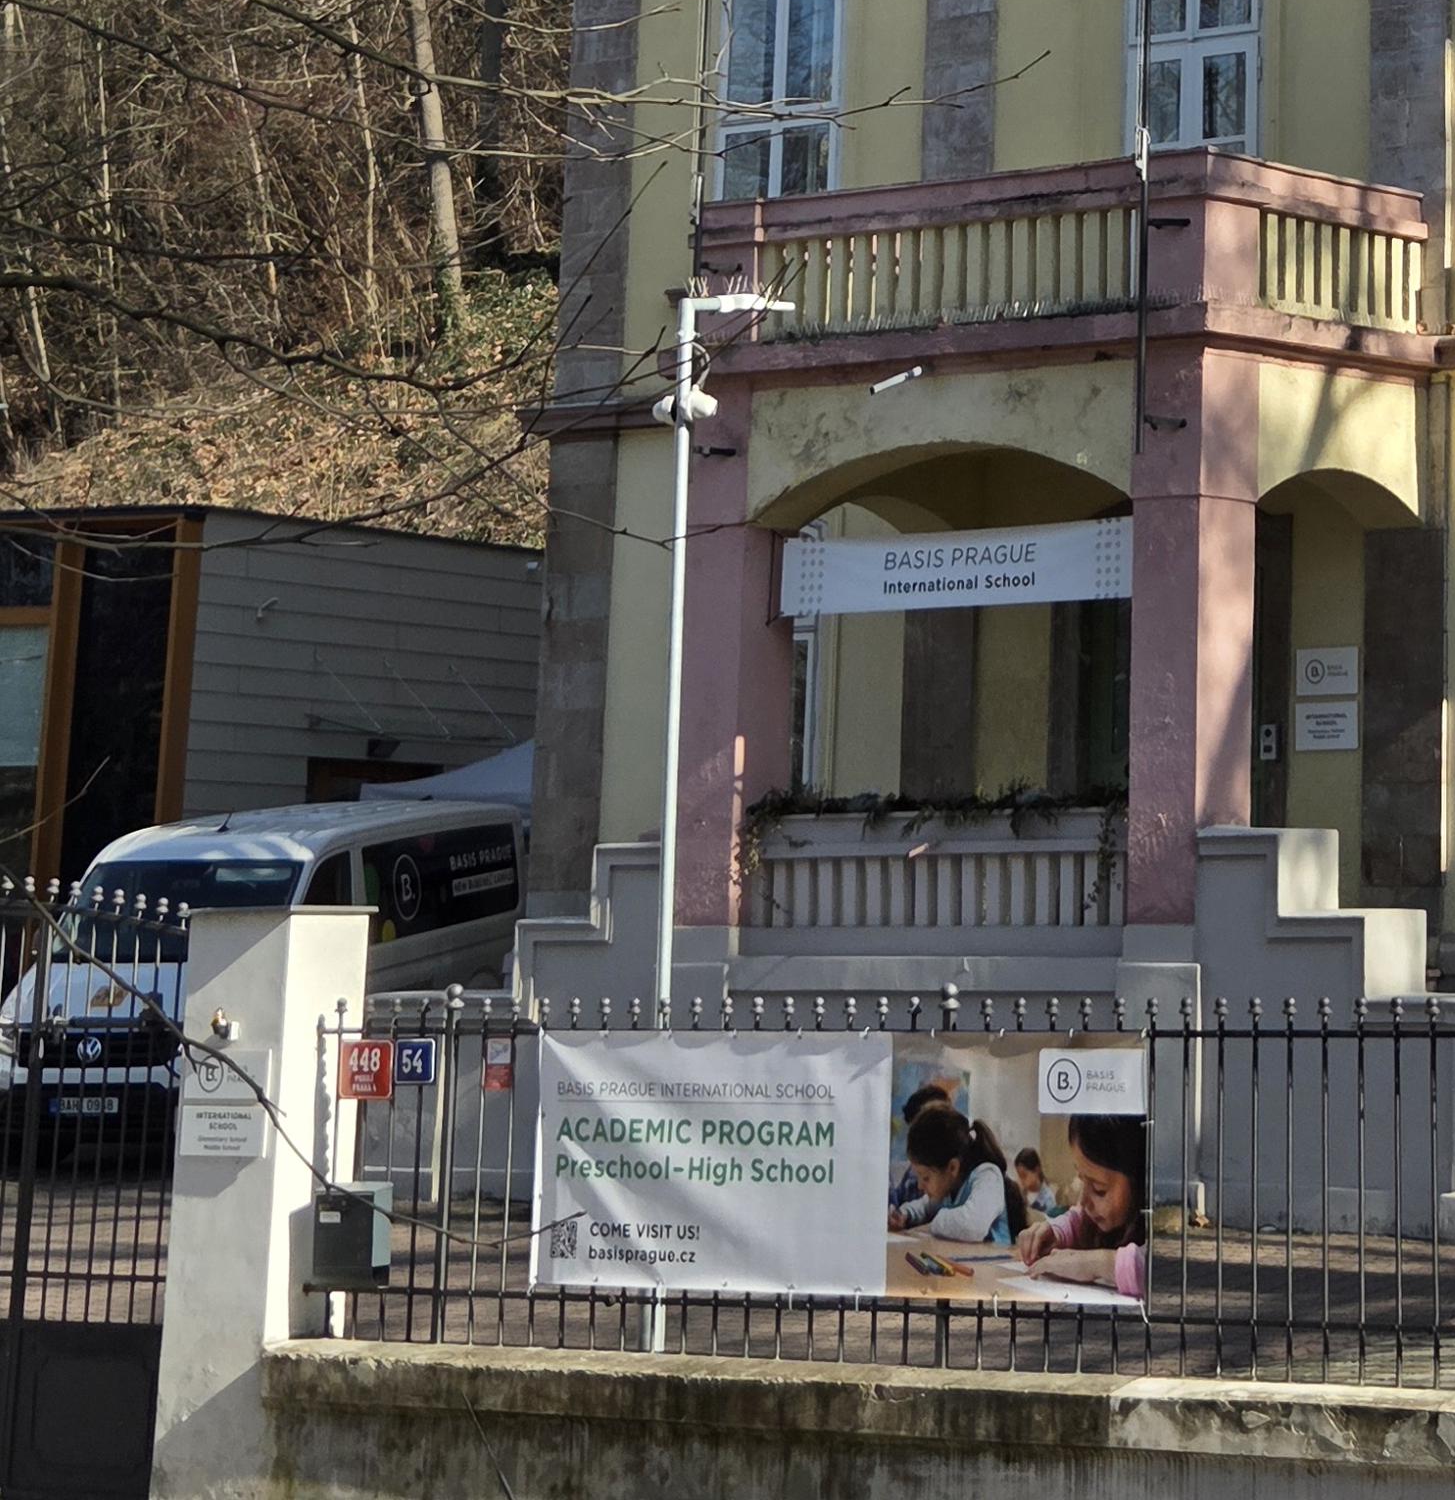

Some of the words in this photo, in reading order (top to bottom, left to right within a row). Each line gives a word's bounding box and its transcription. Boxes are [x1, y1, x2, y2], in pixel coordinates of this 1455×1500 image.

[884, 549, 944, 570] BASIS
[951, 542, 1037, 567] PRAGUE
[883, 575, 978, 594] International
[984, 571, 1035, 589] School
[449, 851, 477, 871] BASIS
[479, 844, 512, 864] PRAGUE
[349, 1047, 381, 1072] 448
[402, 1049, 423, 1074] 54
[1057, 1071, 1073, 1090] B.
[1086, 1070, 1114, 1080] BASIS
[557, 1081, 594, 1095] BASIS
[600, 1081, 656, 1097] PRAGUE
[660, 1082, 771, 1098] INTERNATIONAL
[776, 1083, 835, 1099] SCHOOL
[1086, 1082, 1126, 1092] PRAGUE
[556, 1117, 692, 1144] ACADEMIC
[701, 1119, 835, 1147] PROGRAM
[751, 1158, 834, 1184] School
[590, 1222, 631, 1238] COME
[636, 1223, 673, 1239] VISIT
[677, 1225, 700, 1240] US!
[588, 1244, 696, 1264] basisprague.cz
